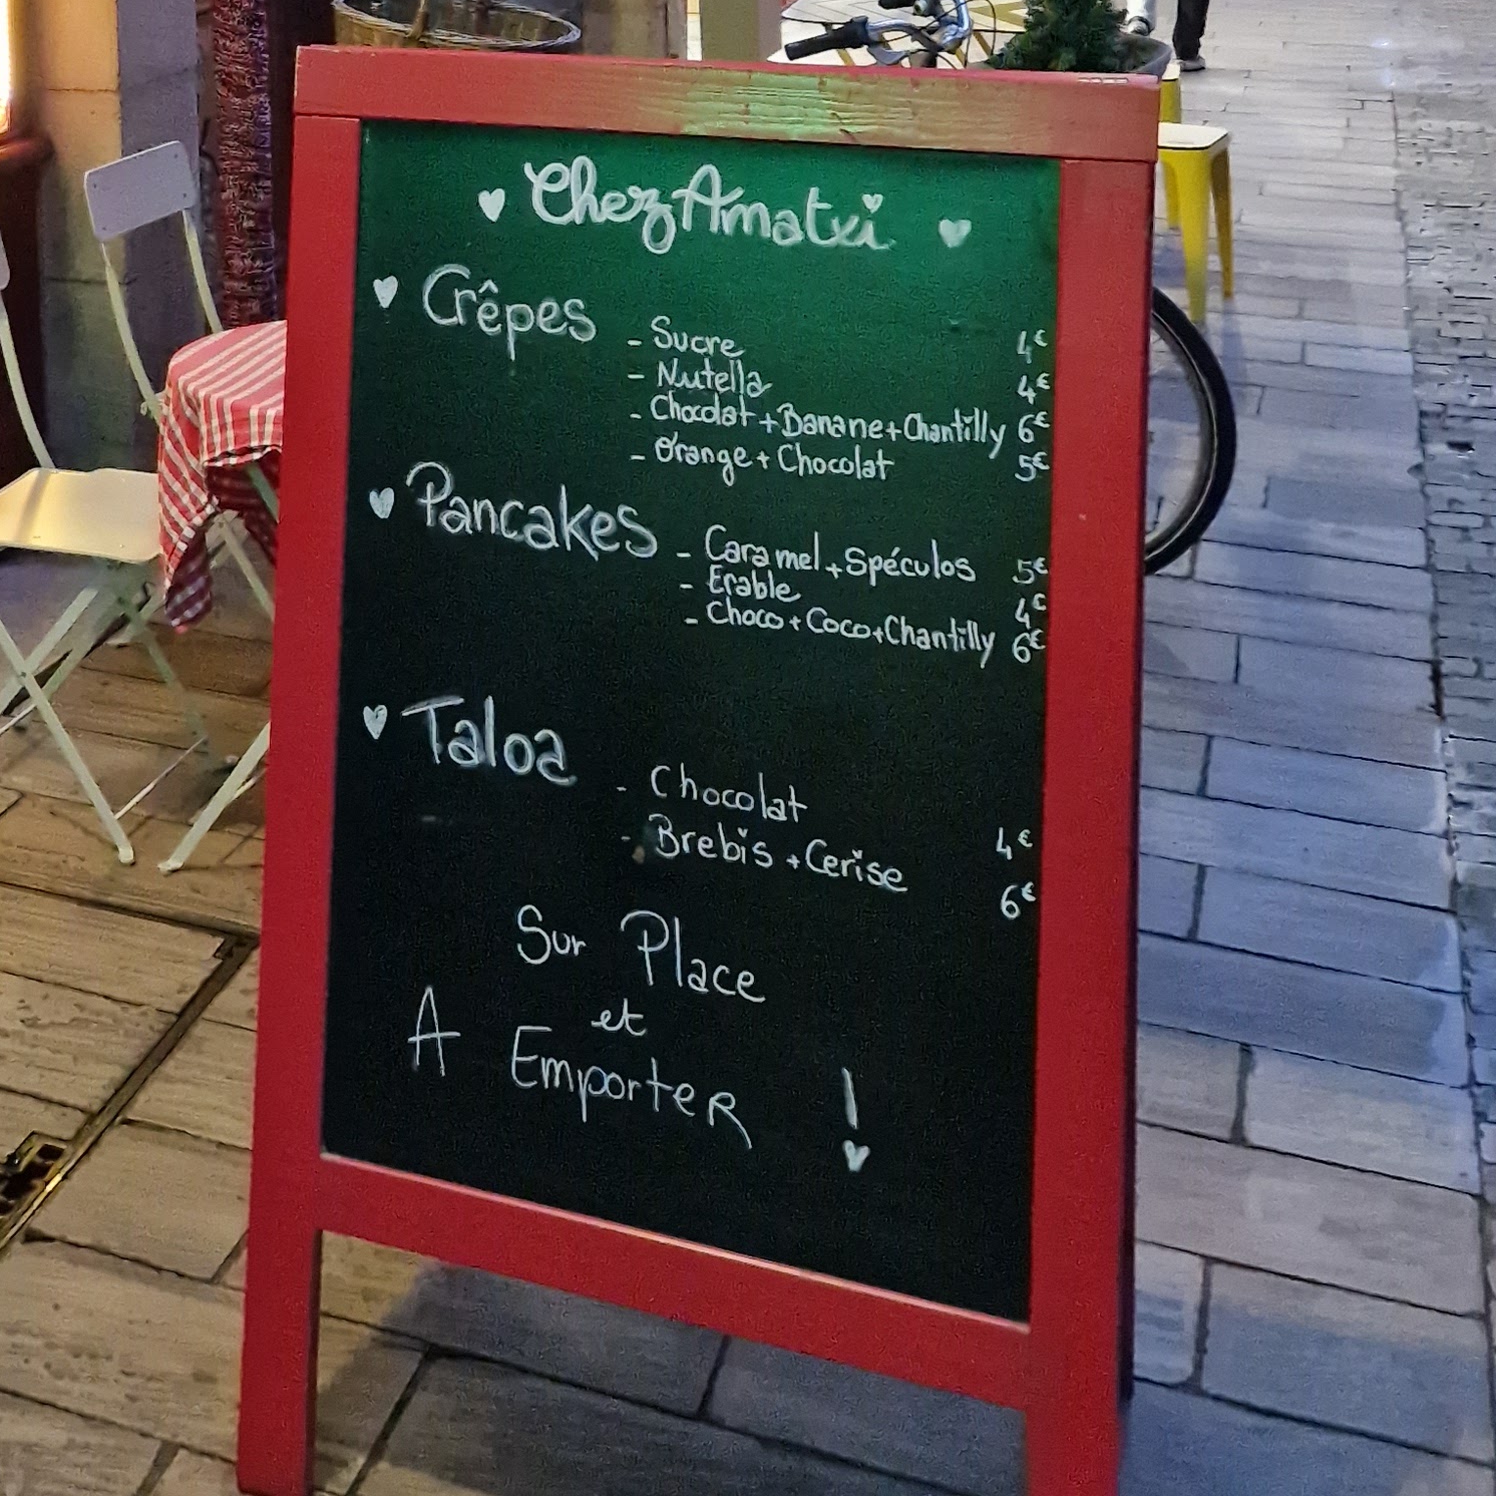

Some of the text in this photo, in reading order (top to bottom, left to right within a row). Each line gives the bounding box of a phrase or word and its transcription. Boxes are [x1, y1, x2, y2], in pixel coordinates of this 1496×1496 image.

[524, 156, 888, 254] Chez Amatxi
[423, 264, 596, 361] Crêpes
[651, 316, 744, 358] Sucre
[657, 358, 772, 398] Nutella
[651, 390, 755, 423] Chocolat
[777, 403, 883, 438] Banane
[904, 408, 1006, 459] Chantilly
[655, 432, 753, 486] Orange
[778, 443, 894, 479] Chocolat
[406, 462, 657, 561] Pancakes
[706, 525, 819, 570] Caramel
[845, 539, 975, 586] Spéculos
[706, 600, 783, 631] Choco
[806, 607, 871, 638] Coco
[885, 615, 995, 668] Chantilly
[402, 696, 575, 785] Taloa
[649, 763, 807, 822] Chocolat
[649, 813, 774, 867] Brebis
[805, 839, 908, 891] Cerise
[518, 905, 765, 1003] Sur Place
[408, 986, 460, 1076] A
[591, 998, 646, 1036] et
